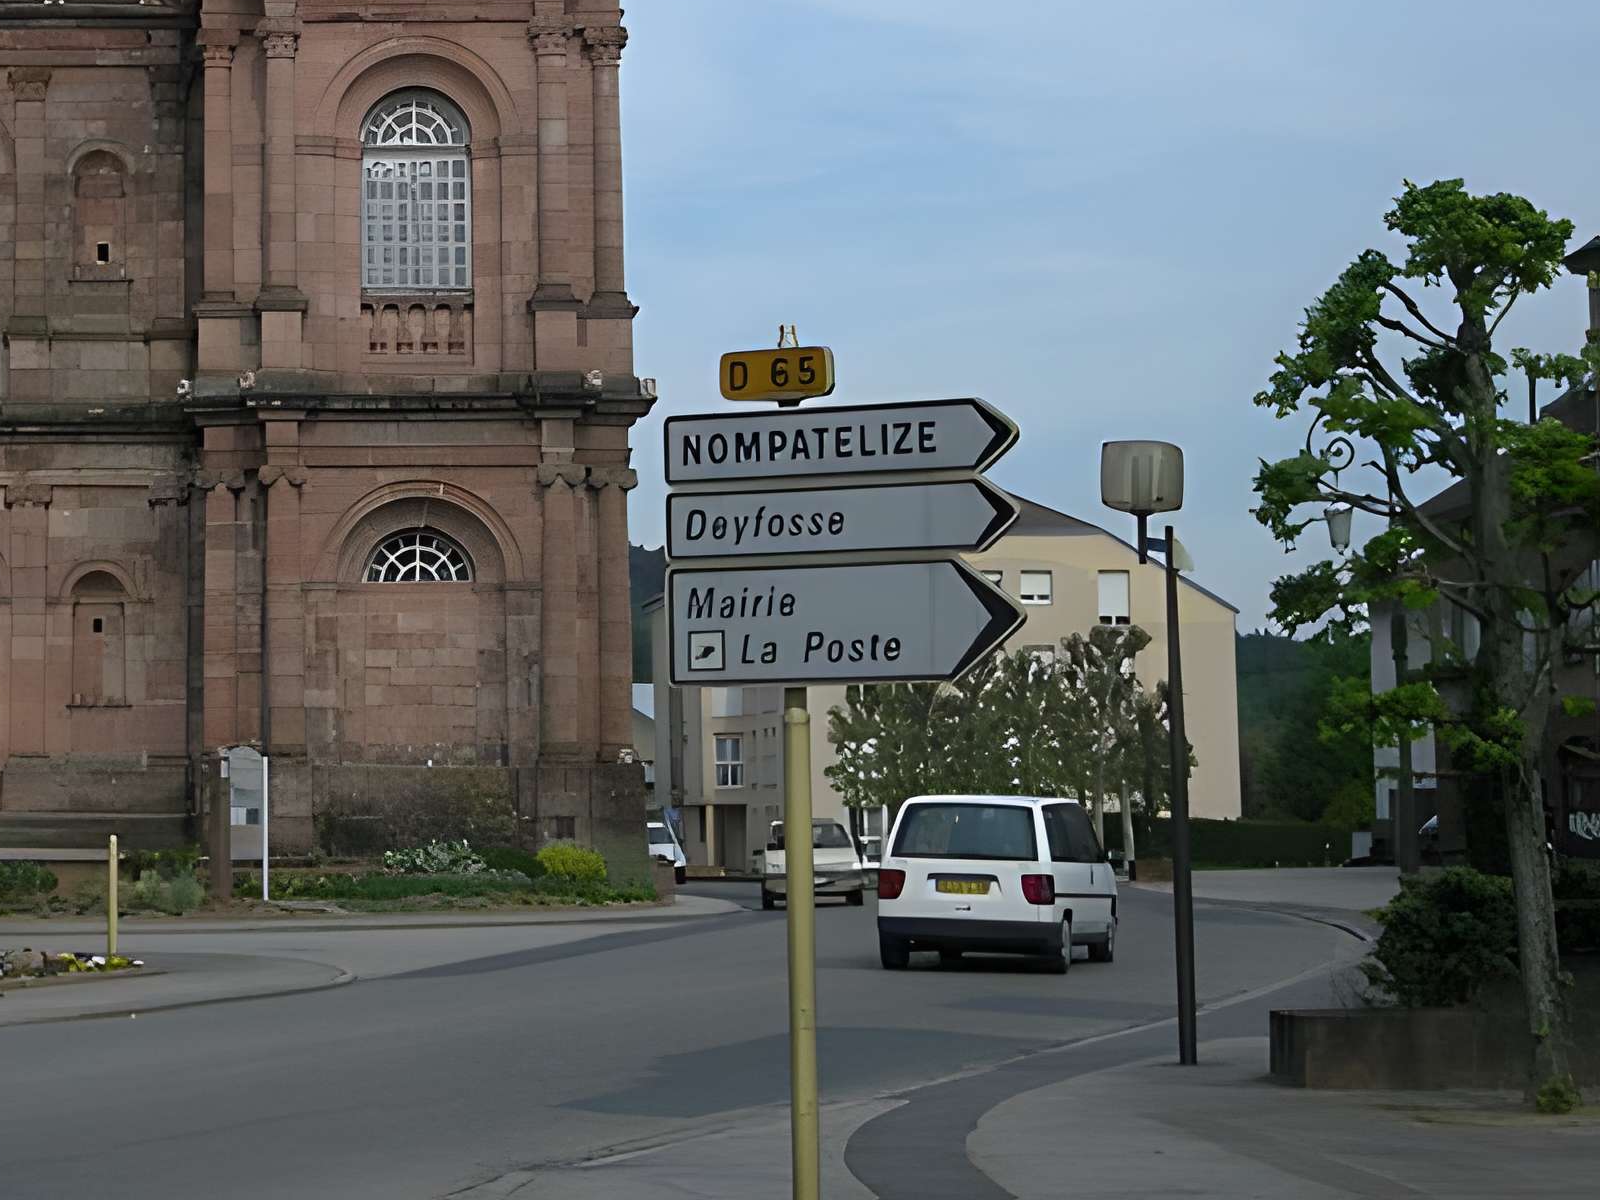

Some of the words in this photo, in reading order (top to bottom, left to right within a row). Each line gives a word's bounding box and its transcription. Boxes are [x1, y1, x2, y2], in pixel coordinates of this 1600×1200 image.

[729, 361, 748, 391] D
[771, 356, 815, 387] 65
[682, 421, 937, 466] NOMPATELIZE
[685, 505, 844, 546] Deyfosse
[687, 585, 796, 619] Mairie
[741, 633, 778, 664] La
[803, 631, 901, 663] Poste
